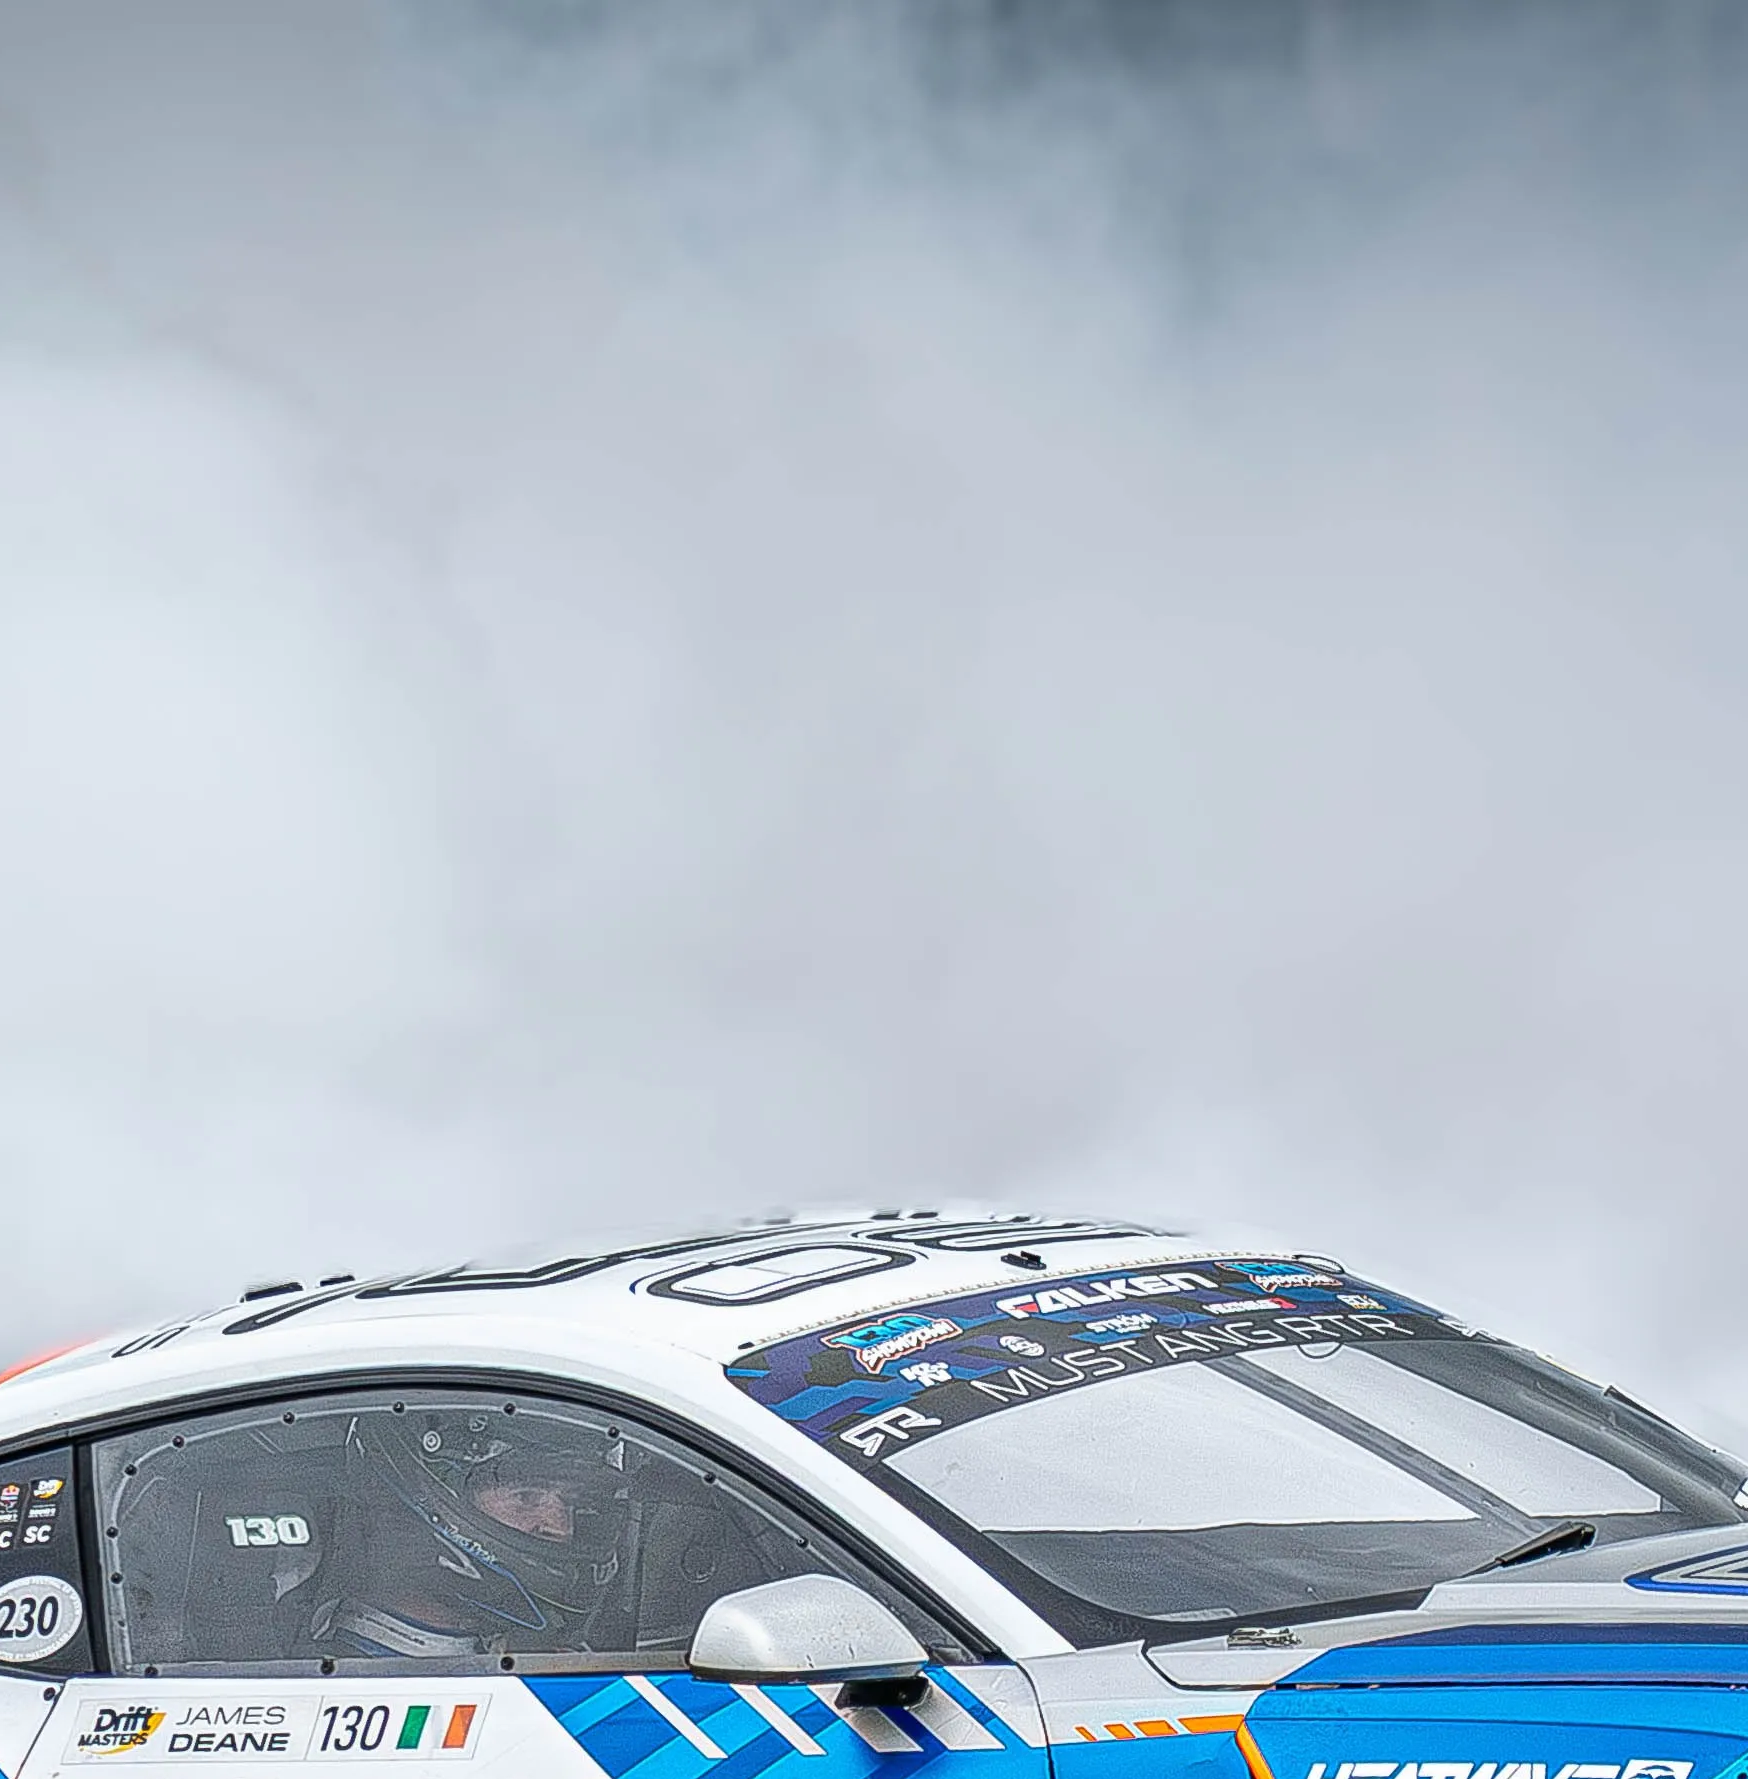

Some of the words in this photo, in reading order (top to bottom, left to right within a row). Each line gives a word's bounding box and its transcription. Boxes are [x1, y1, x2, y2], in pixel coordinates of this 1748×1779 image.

[996, 1272, 1220, 1319] FALKEN
[970, 1322, 1286, 1402] MUSTANG
[1273, 1314, 1414, 1340] RTR
[23, 1524, 52, 1544] SC
[225, 1515, 310, 1547] 130
[94, 1707, 155, 1734] Drift
[176, 1706, 286, 1726] JAMES
[321, 1705, 390, 1751] 130
[78, 1731, 148, 1748] MASTERS
[168, 1732, 290, 1753] DEANE
